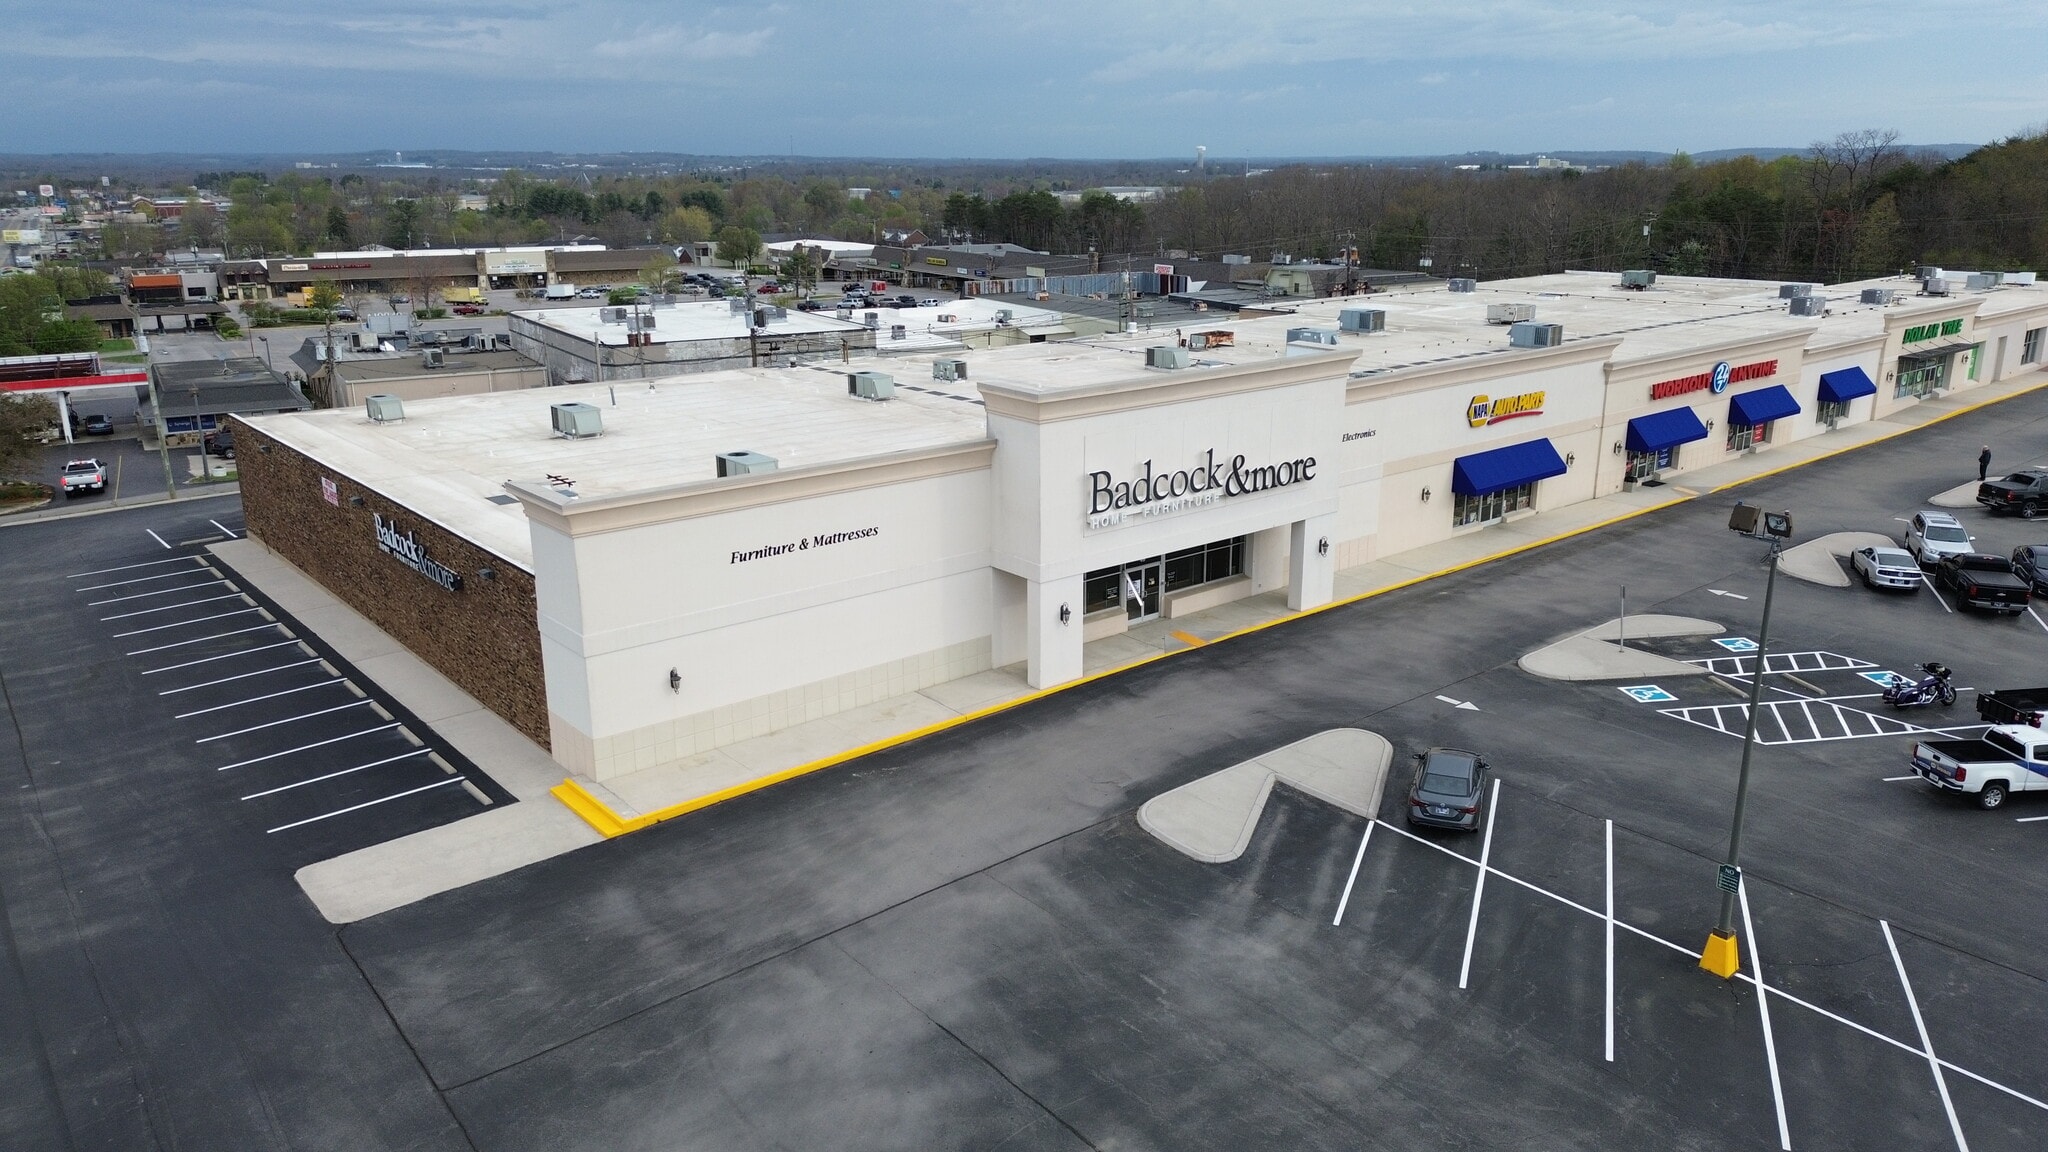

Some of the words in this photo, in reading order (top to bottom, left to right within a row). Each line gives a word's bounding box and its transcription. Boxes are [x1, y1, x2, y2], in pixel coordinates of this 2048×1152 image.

[1902, 323, 1940, 344] DOLLAR
[1941, 318, 1964, 336] TREE
[1730, 359, 1778, 384] ANYTIME
[1652, 372, 1713, 400] WORKOUT
[1473, 403, 1488, 420] NAPA
[1491, 396, 1518, 417] AUTO
[1519, 391, 1546, 412] PARTS
[1342, 428, 1376, 442] Electronics
[1091, 513, 1128, 530] HOME
[1144, 494, 1221, 518] FURNITURE
[730, 543, 795, 564] Furniture
[799, 538, 809, 551] &
[813, 526, 879, 548] Mattresses
